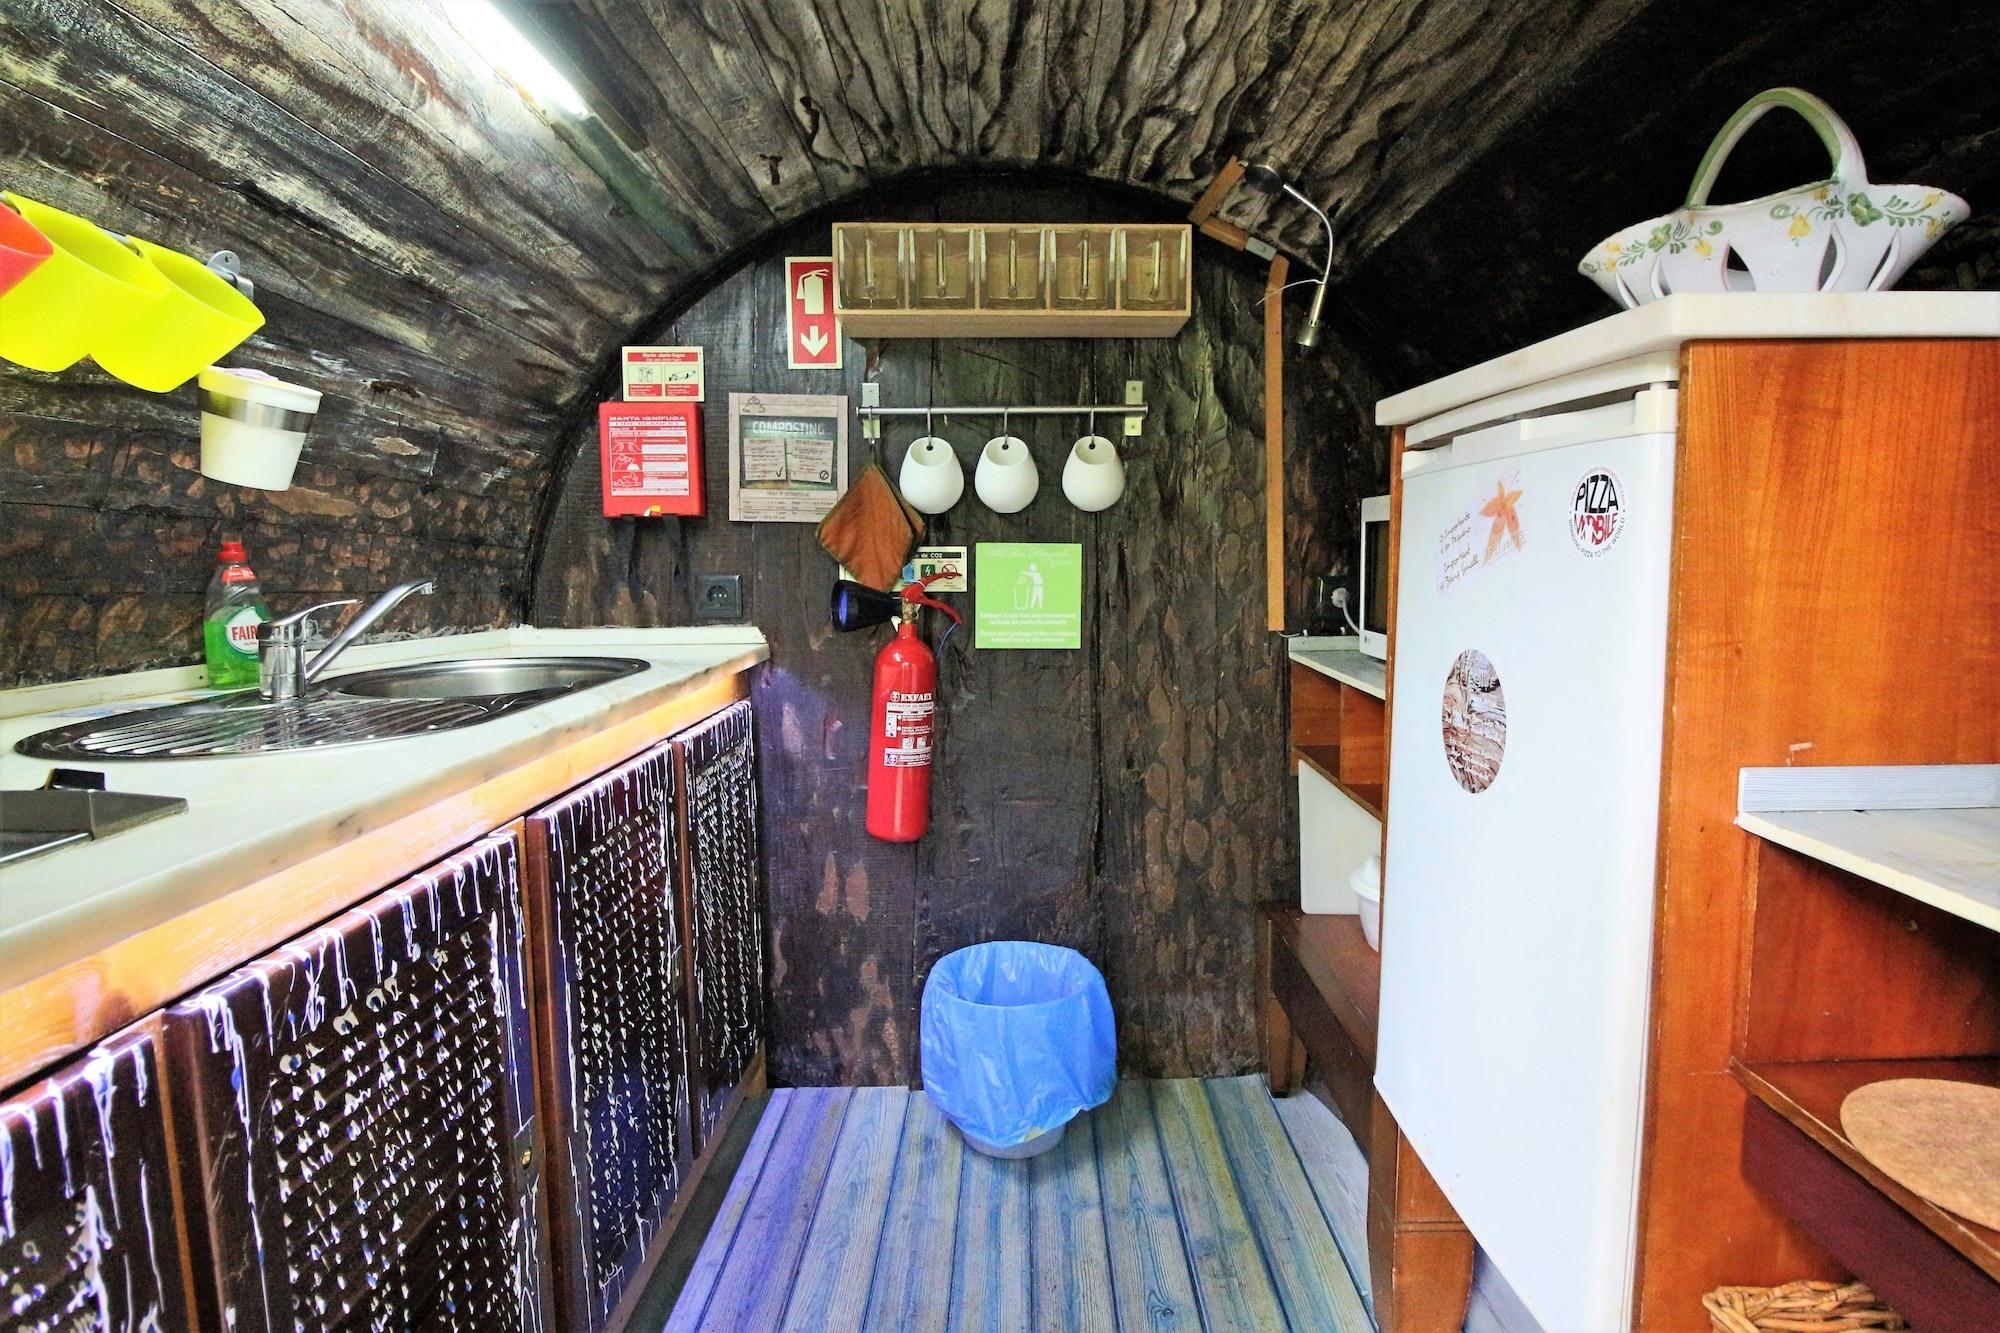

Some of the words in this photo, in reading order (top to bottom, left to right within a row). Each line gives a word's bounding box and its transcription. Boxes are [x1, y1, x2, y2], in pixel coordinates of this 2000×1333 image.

[1575, 474, 1619, 513] PIZZA
[1602, 544, 1613, 553] THE
[1611, 517, 1626, 545] WORLD
[231, 626, 258, 641] FAIR
